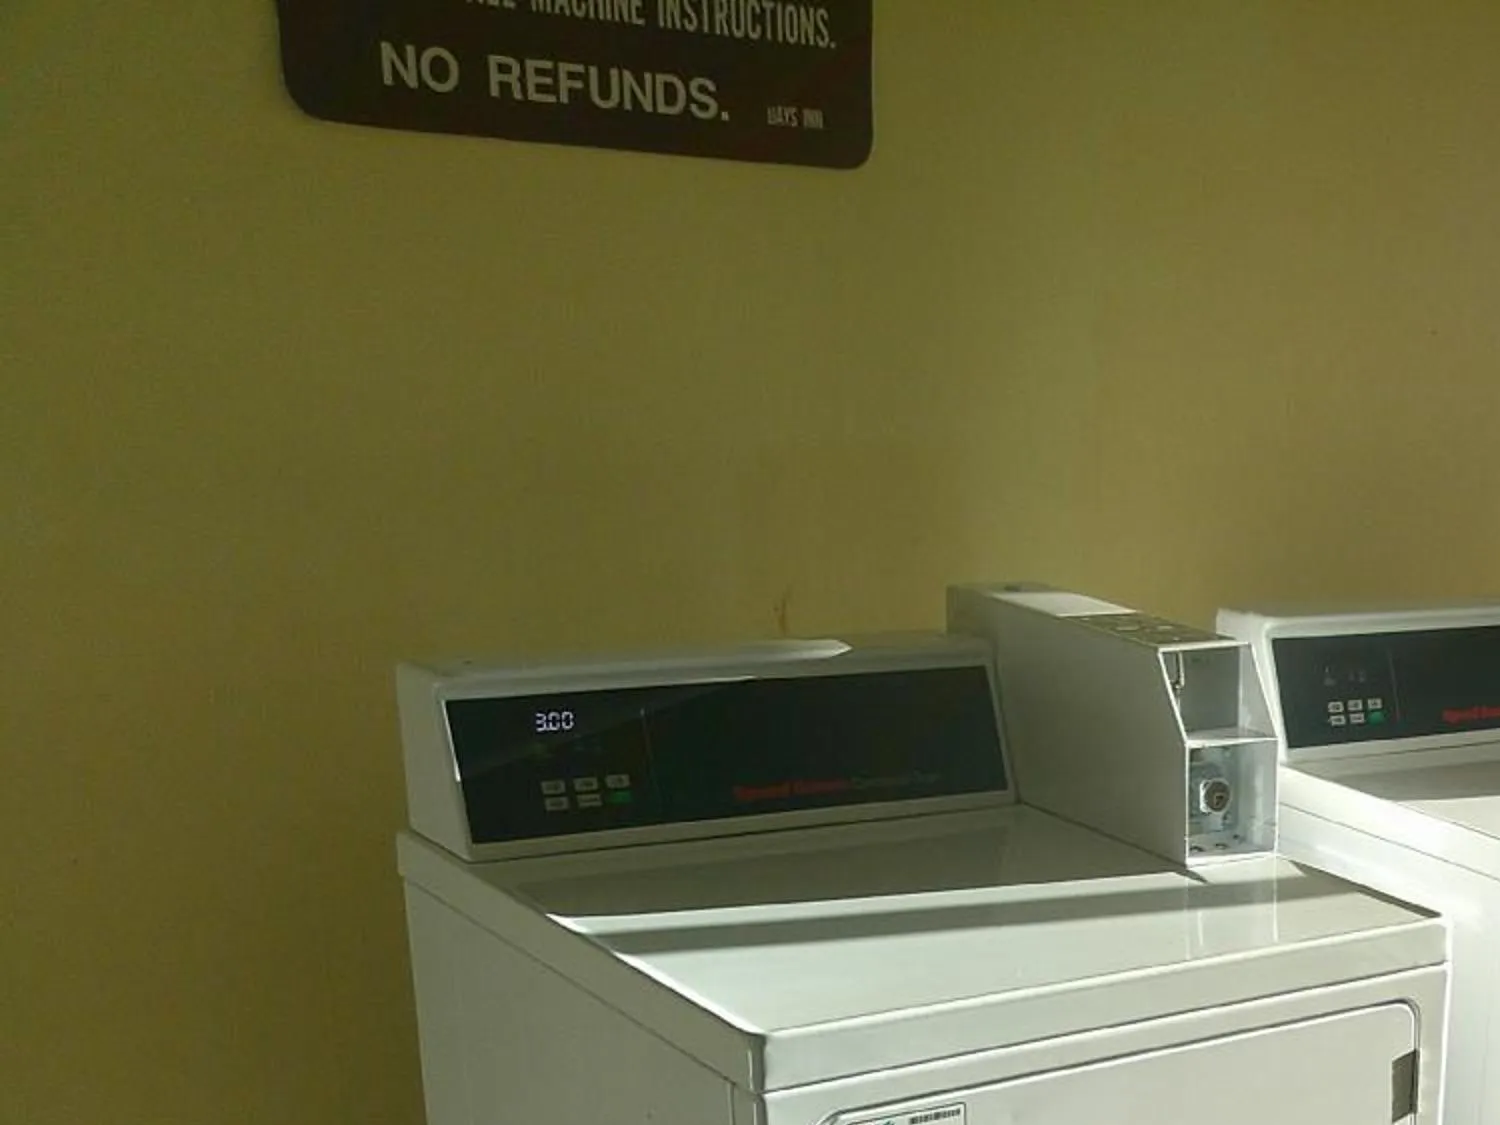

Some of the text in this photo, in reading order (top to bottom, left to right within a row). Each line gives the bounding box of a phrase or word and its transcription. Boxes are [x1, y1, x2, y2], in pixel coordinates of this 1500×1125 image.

[530, 0, 837, 49] HINE INSTRUCTIONS.
[380, 41, 730, 121] NO REFUNDS.
